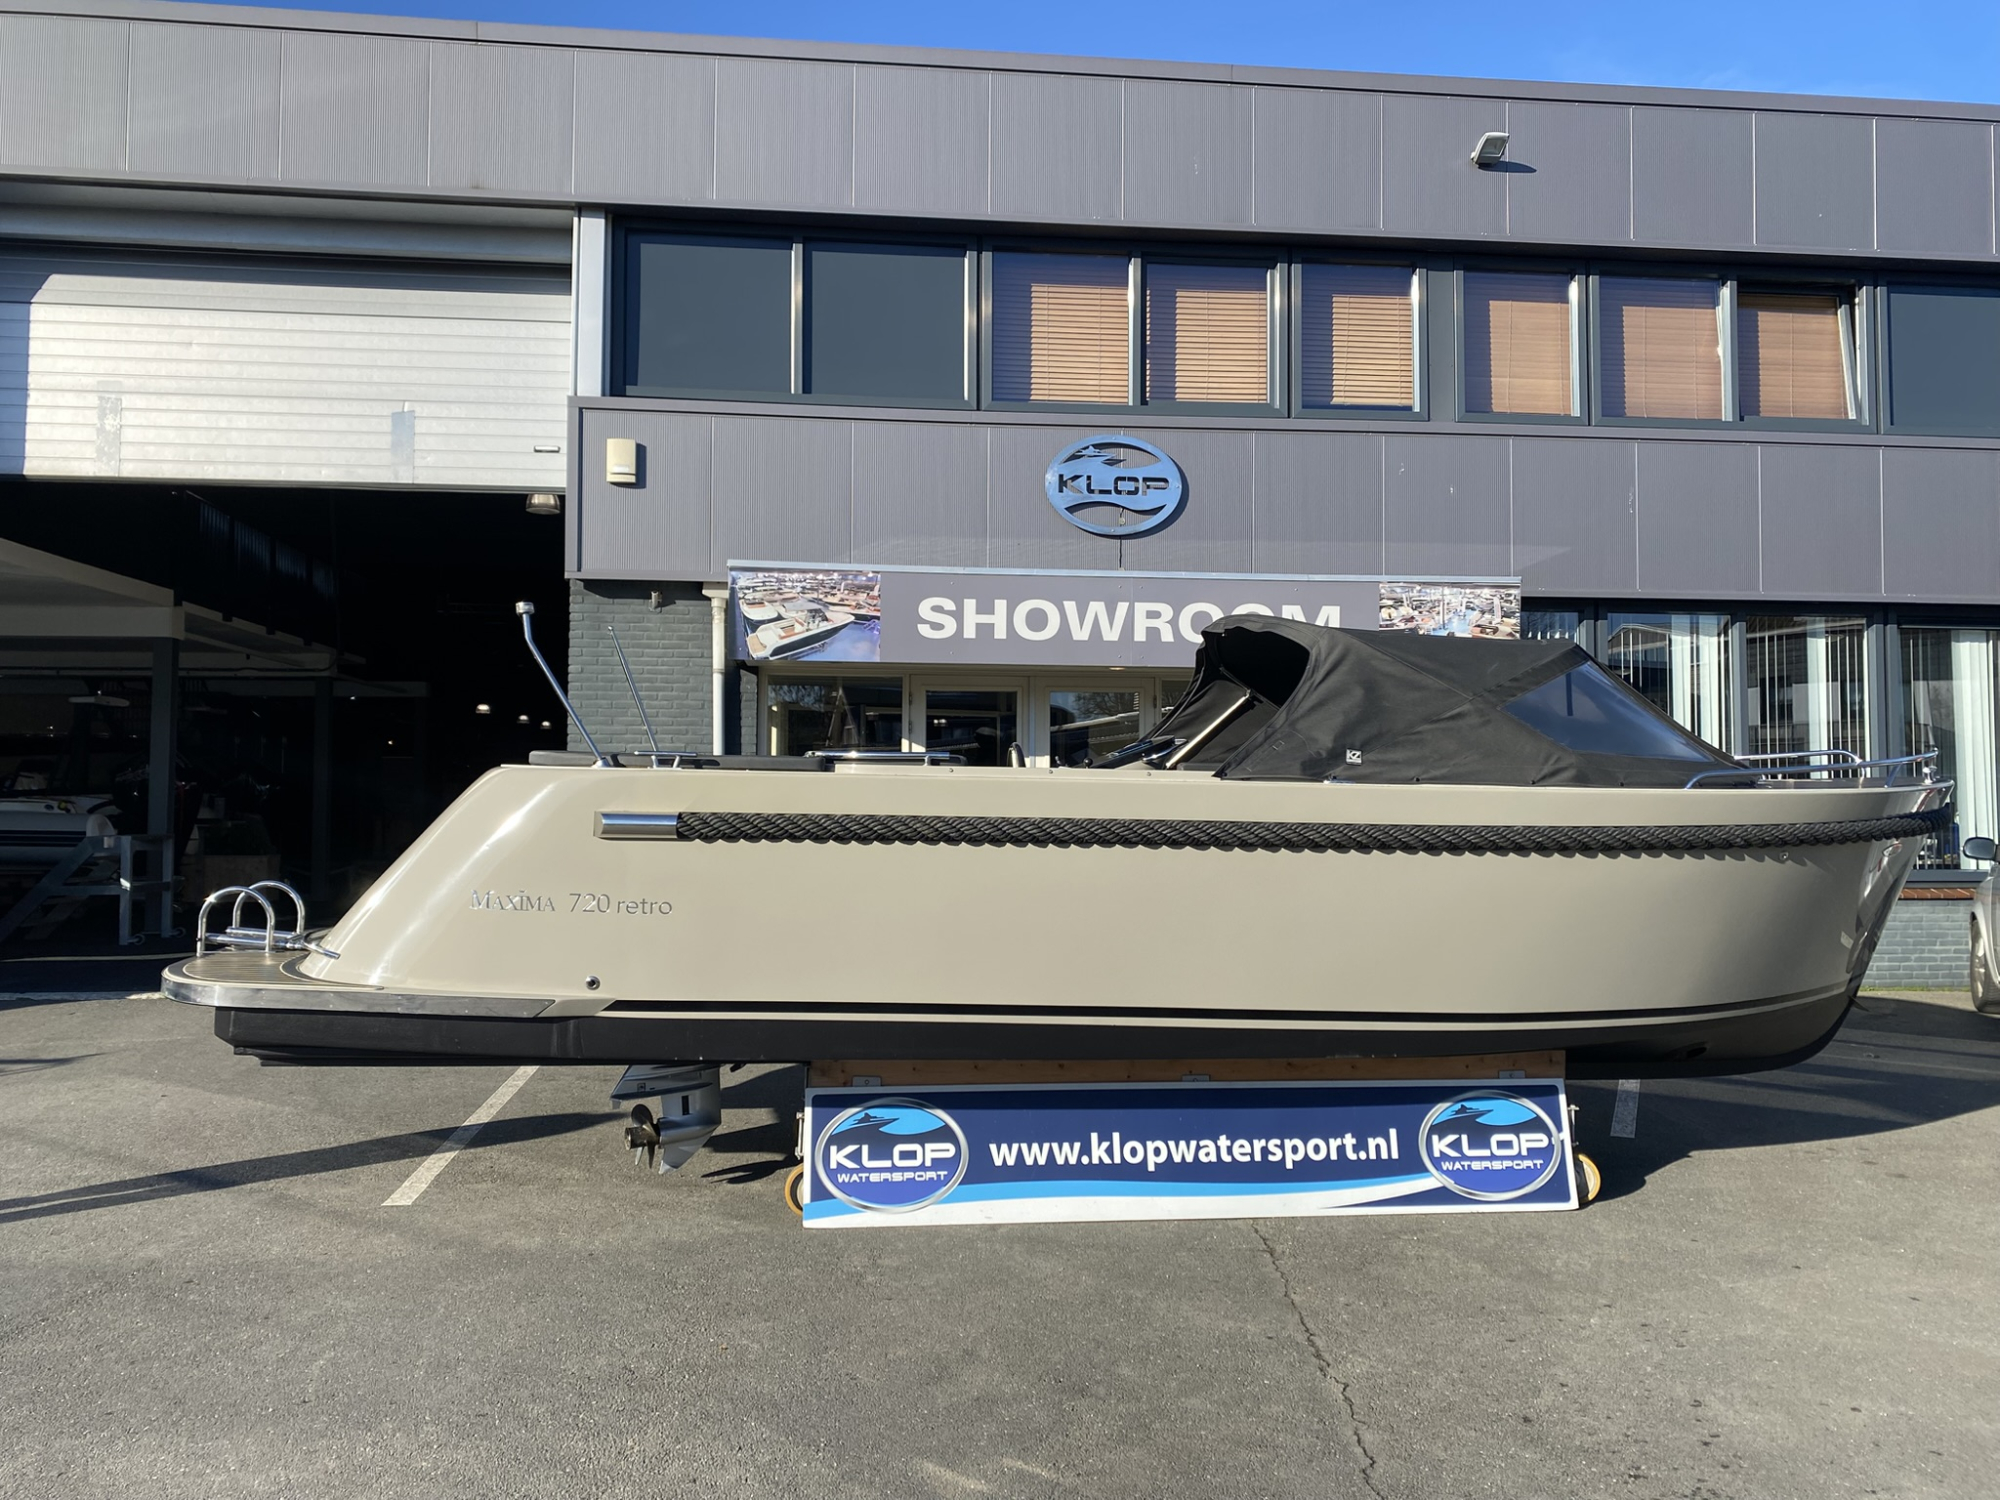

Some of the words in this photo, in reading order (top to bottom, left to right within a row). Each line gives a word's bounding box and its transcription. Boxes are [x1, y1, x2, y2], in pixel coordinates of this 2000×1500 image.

[1058, 473, 1170, 496] KLOP
[917, 597, 1341, 643] SHOWRO
[569, 893, 610, 913] 720
[617, 898, 673, 915] retro
[829, 1142, 956, 1169] KLOP
[989, 1128, 1400, 1172] www.klopwatersport.nl
[1431, 1133, 1549, 1158] KLOP
[837, 1171, 948, 1183] WATERSPORT
[1441, 1160, 1544, 1171] WATERSPORT
